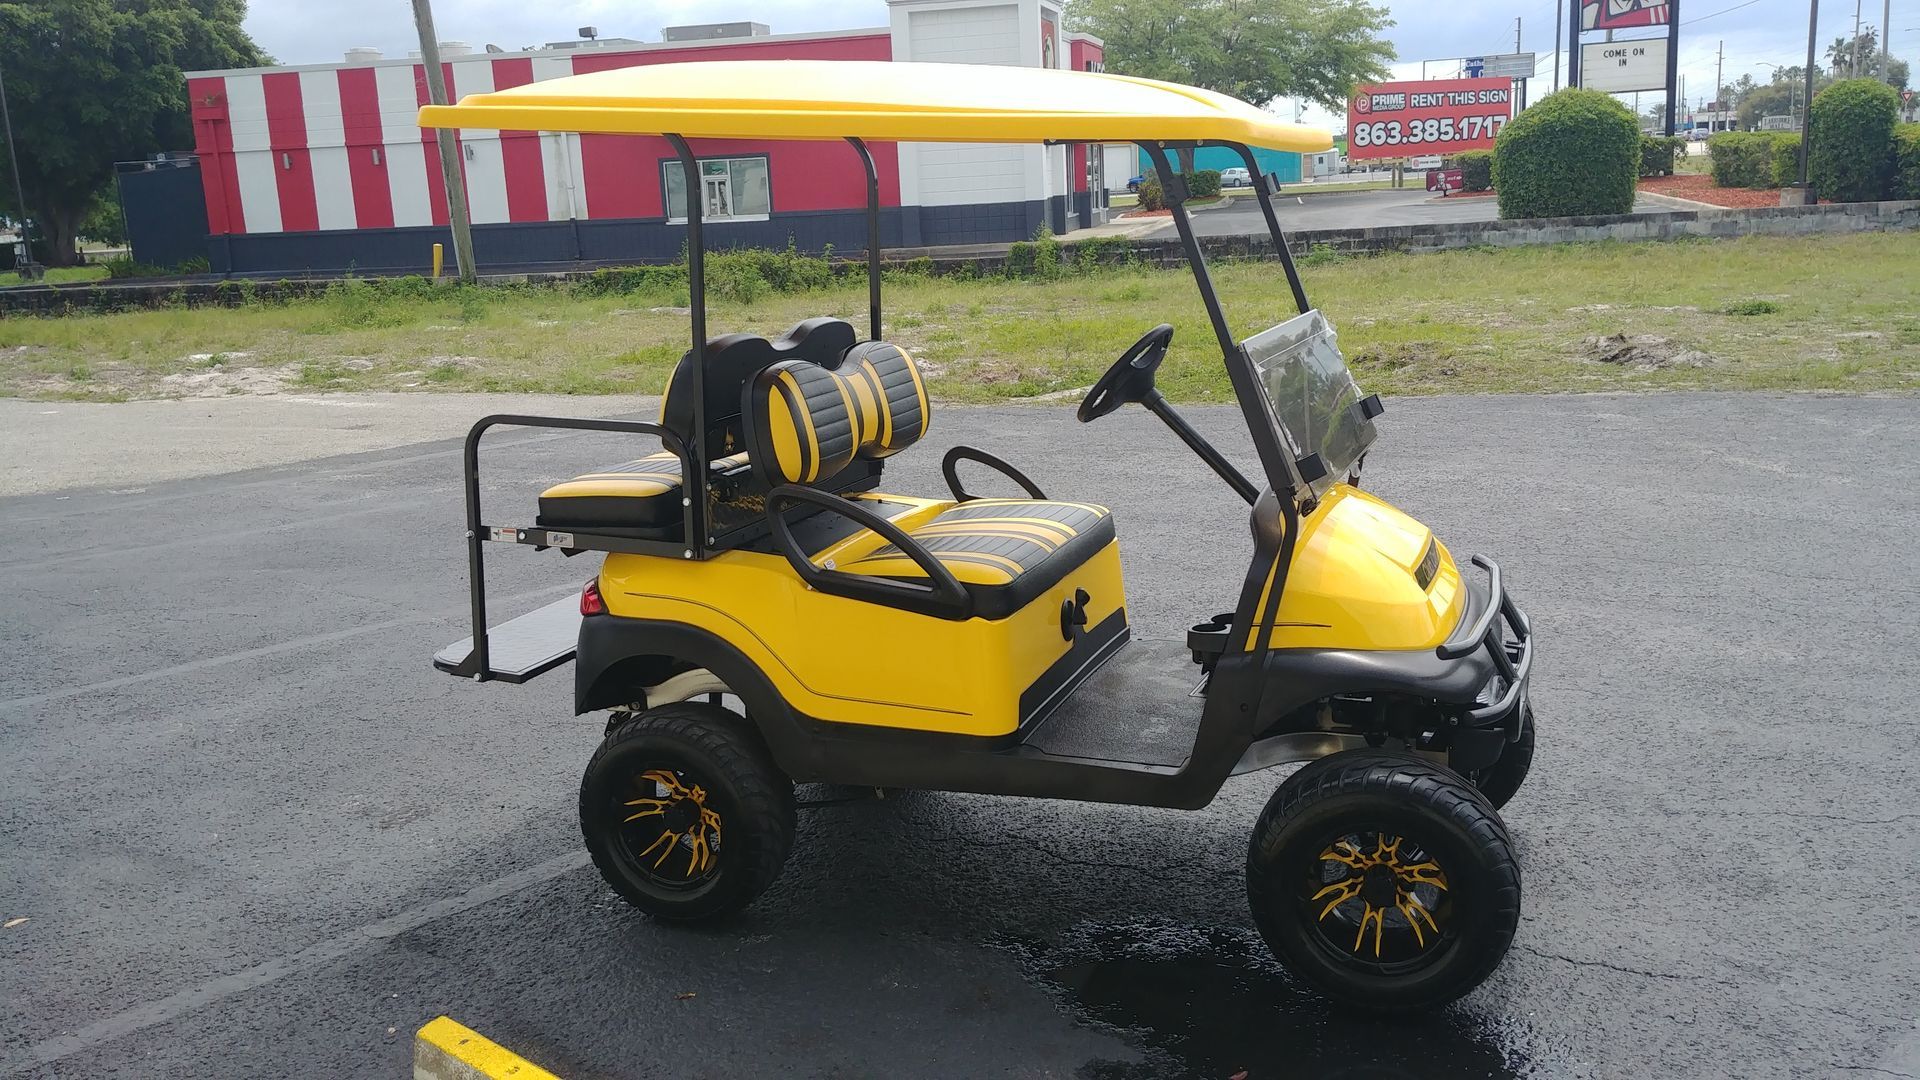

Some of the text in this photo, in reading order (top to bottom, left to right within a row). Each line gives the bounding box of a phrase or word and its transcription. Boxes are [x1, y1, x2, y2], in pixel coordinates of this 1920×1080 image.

[1603, 48, 1645, 58] COME ON
[1618, 58, 1627, 67] IN
[1372, 93, 1405, 105] PRIME
[1410, 89, 1508, 107] RENT THIS SIGN
[1354, 115, 1508, 147] 863.385.1717
